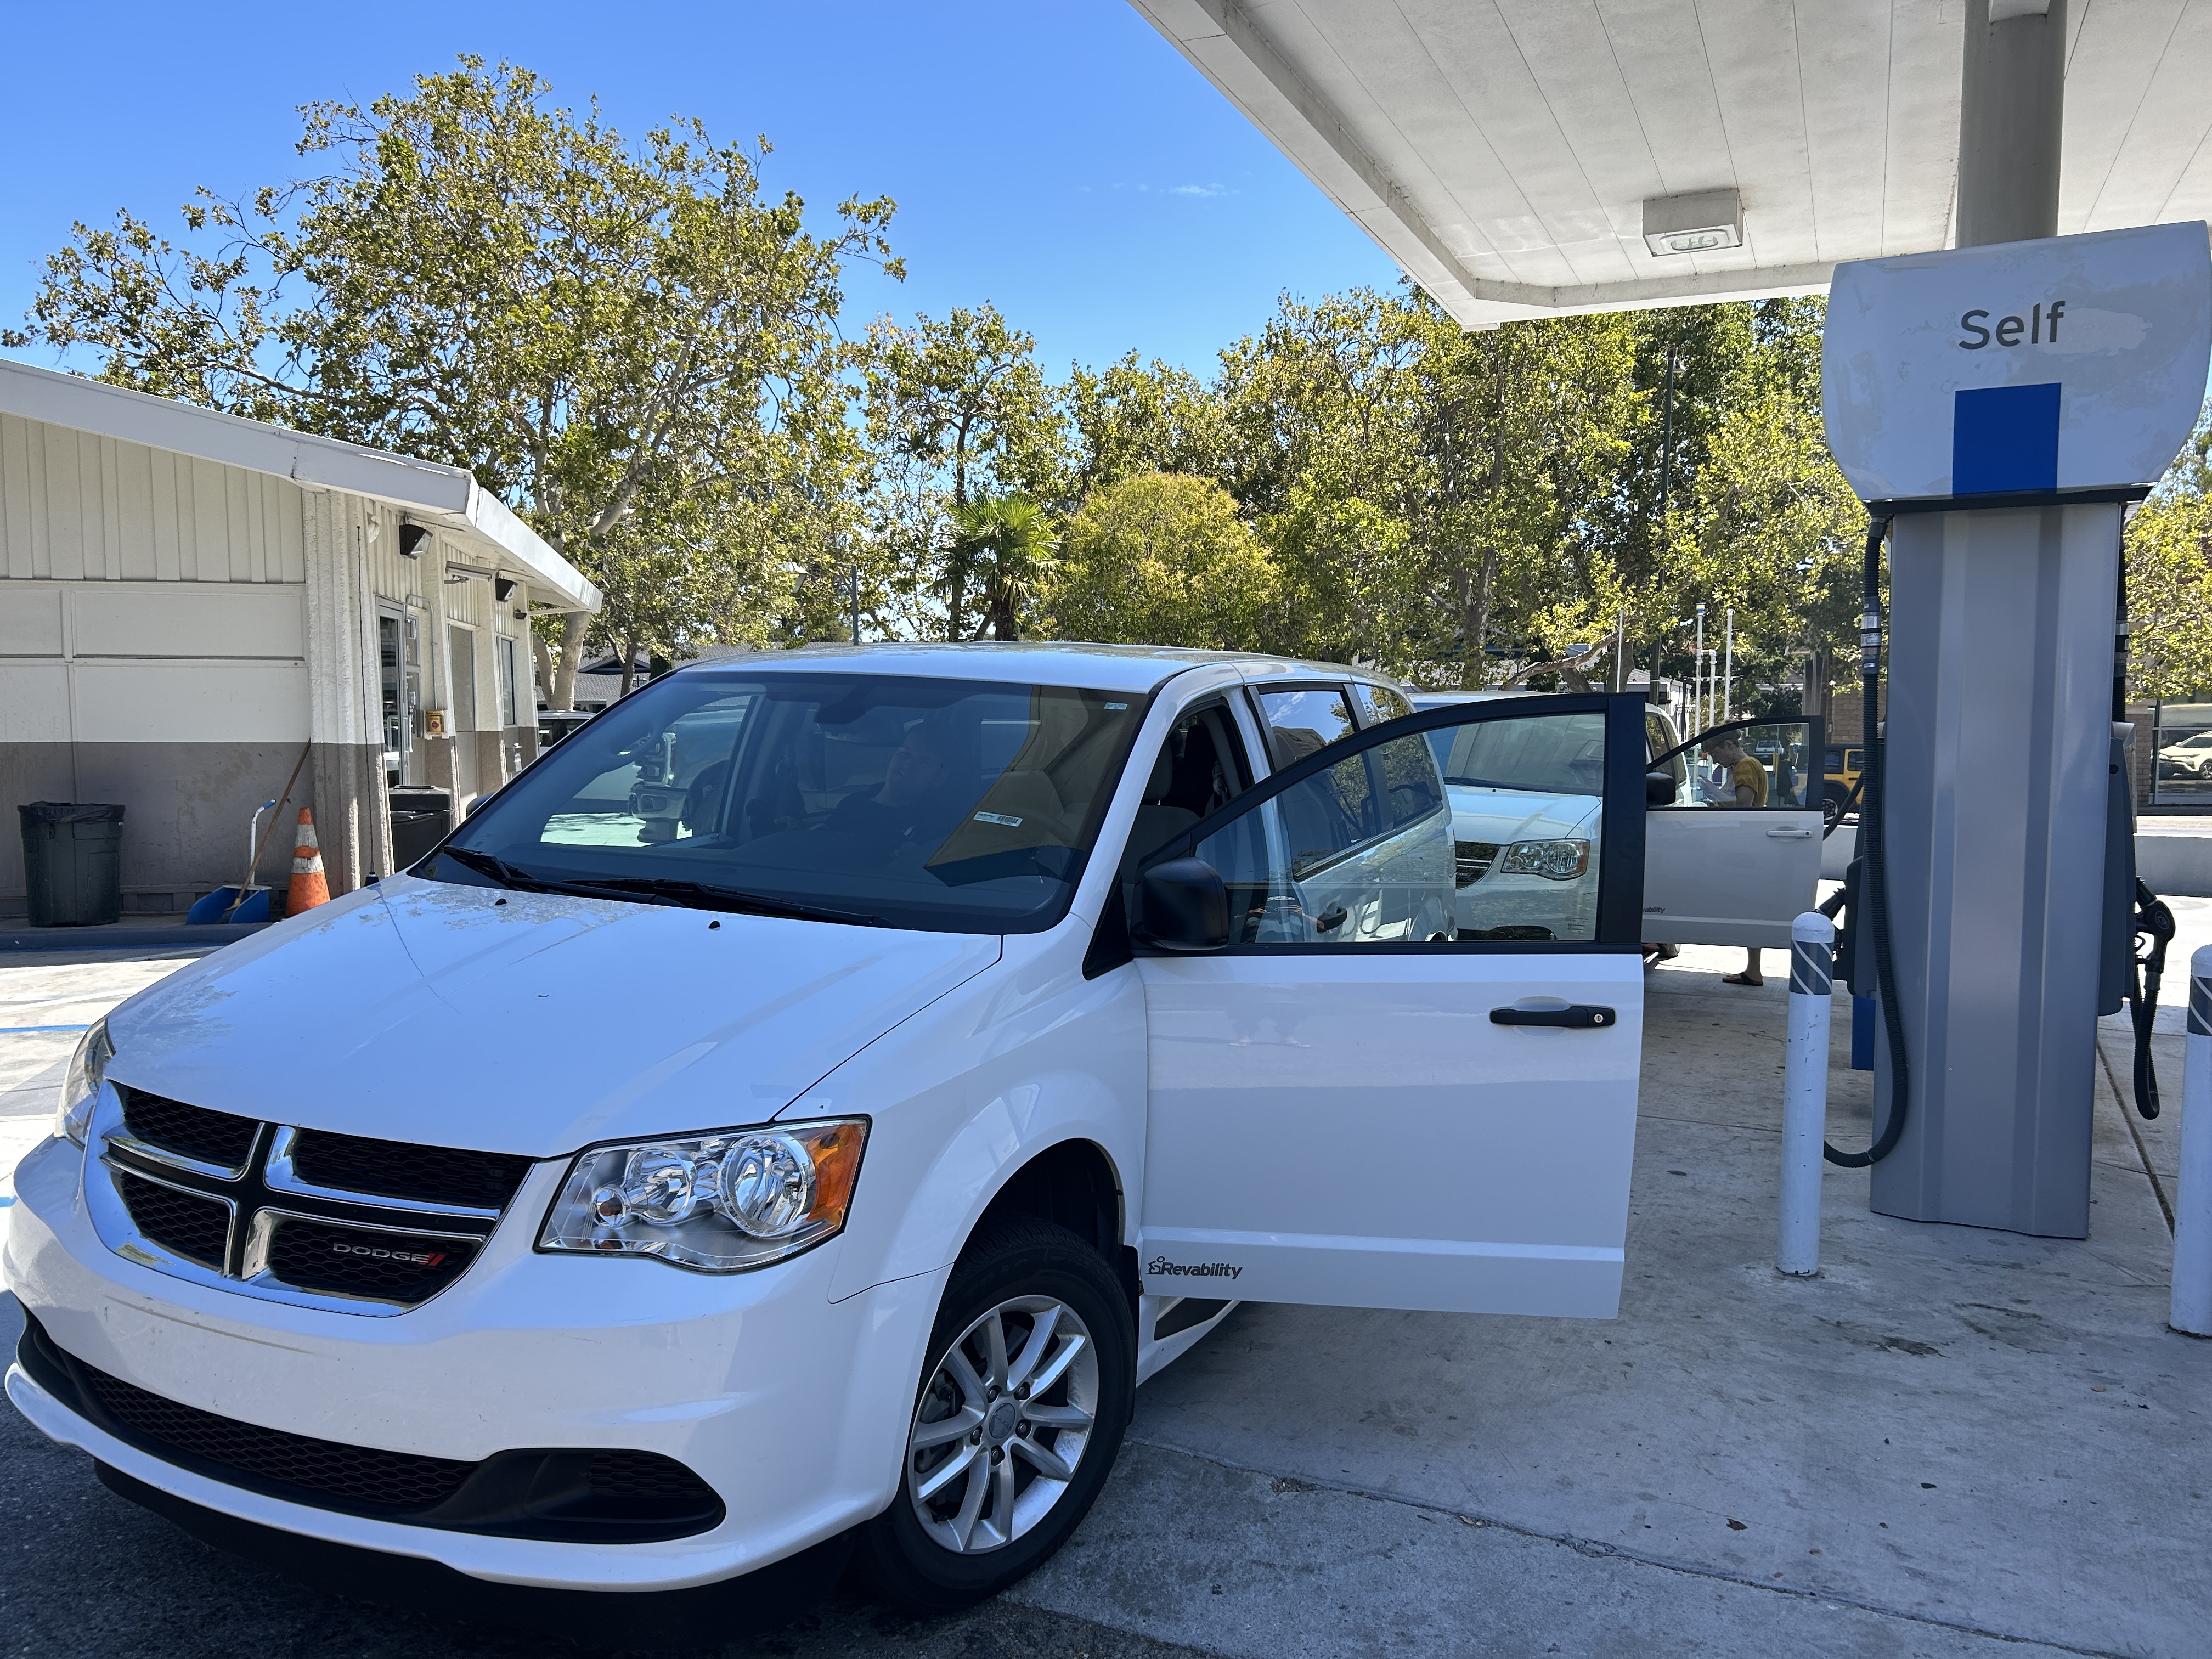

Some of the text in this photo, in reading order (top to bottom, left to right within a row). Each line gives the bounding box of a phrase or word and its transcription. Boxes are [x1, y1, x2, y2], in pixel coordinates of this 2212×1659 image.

[1959, 301, 2065, 349] Self
[332, 1243, 430, 1263] DODGE
[1161, 1262, 1243, 1280] Revability
